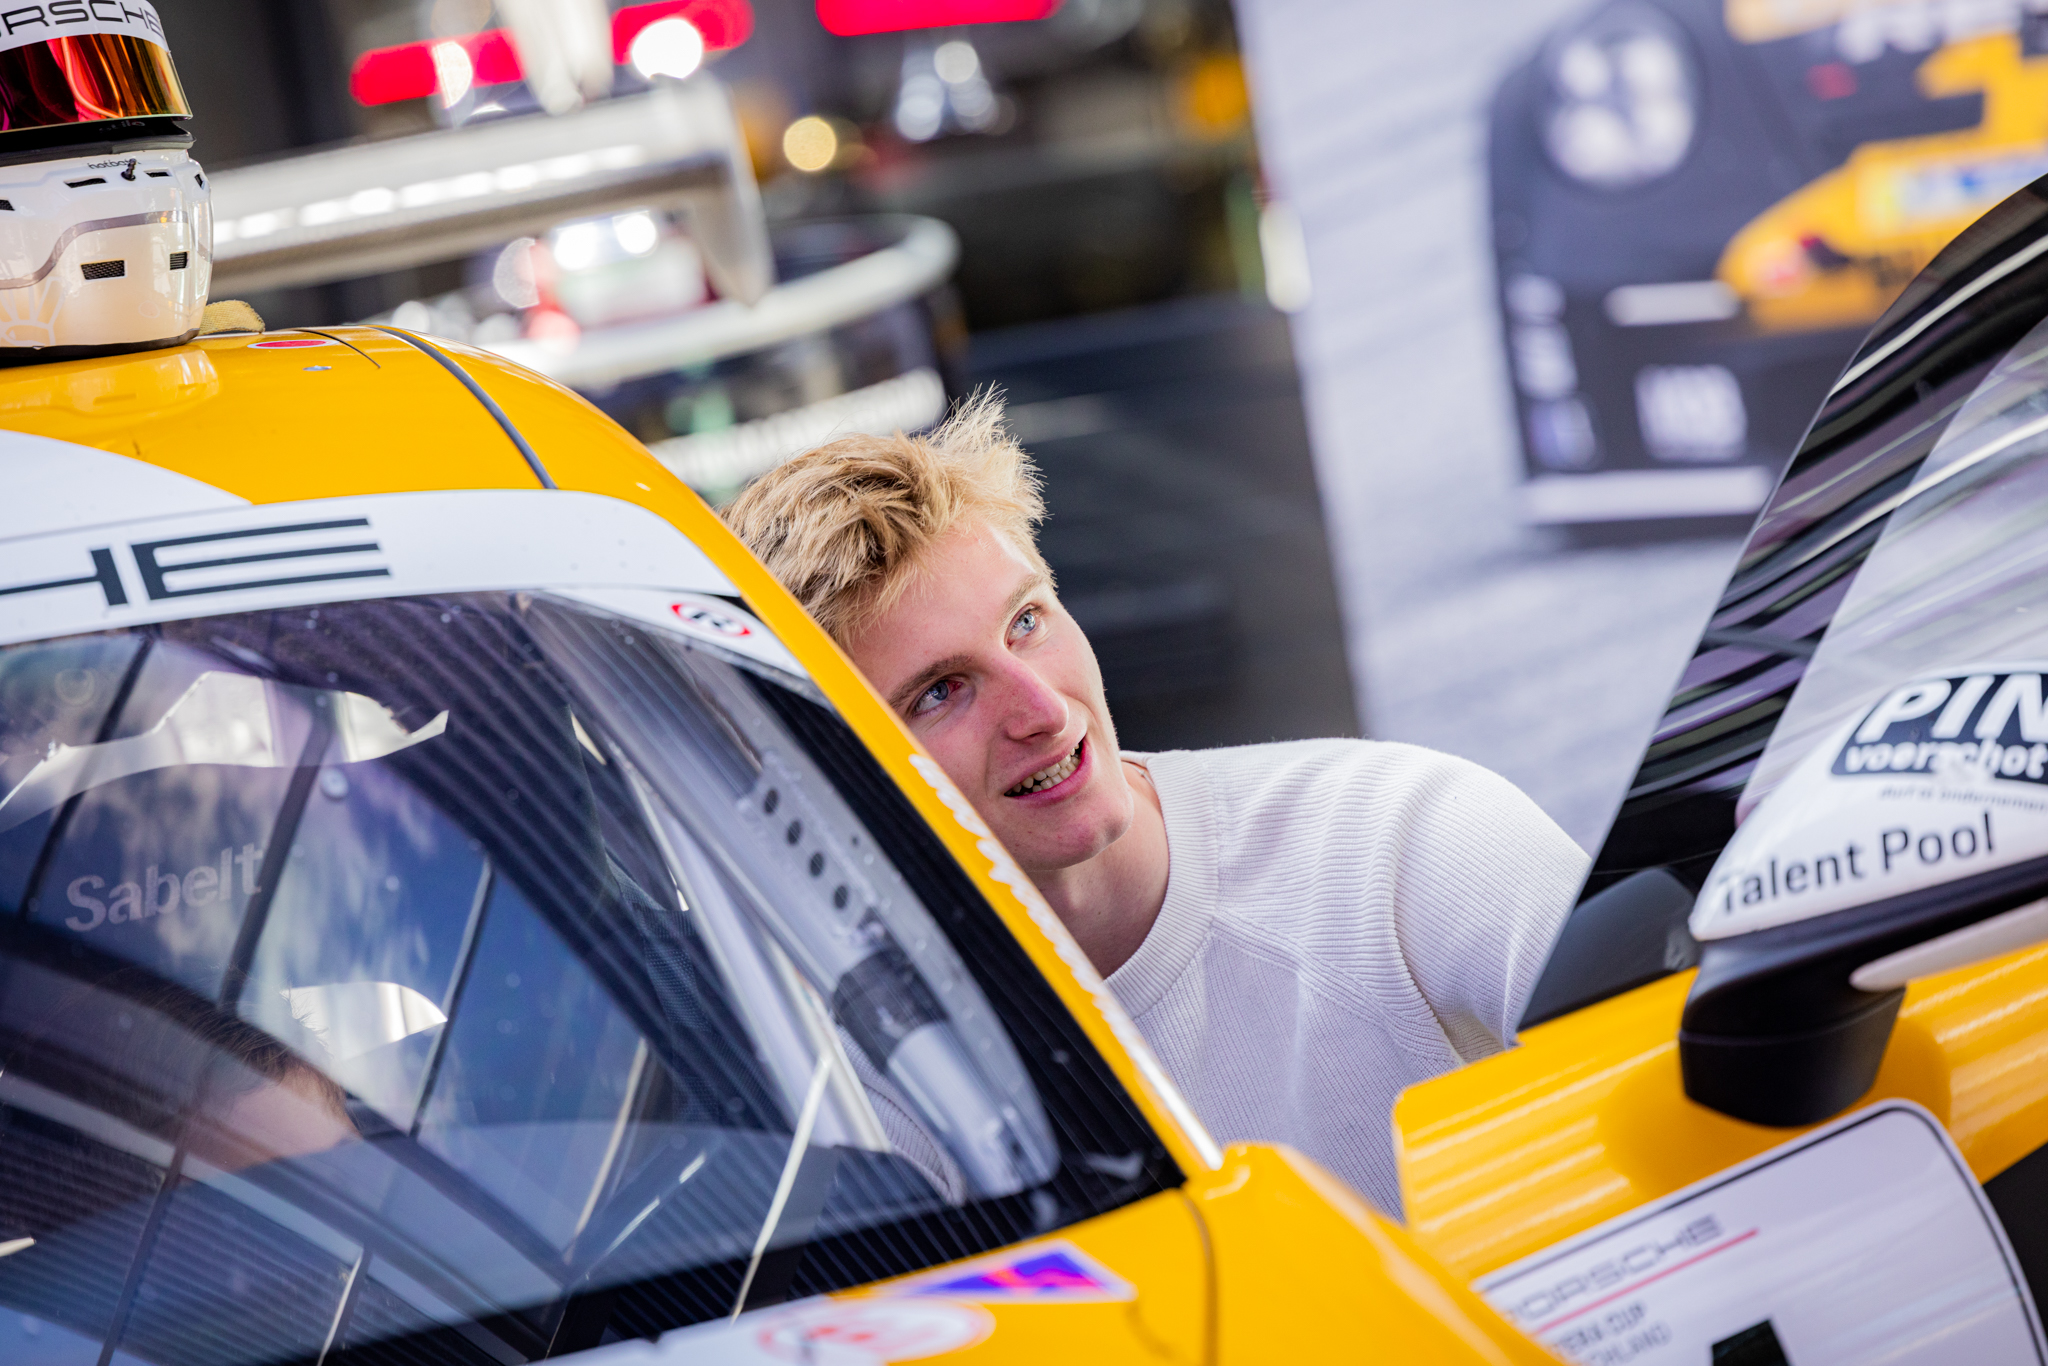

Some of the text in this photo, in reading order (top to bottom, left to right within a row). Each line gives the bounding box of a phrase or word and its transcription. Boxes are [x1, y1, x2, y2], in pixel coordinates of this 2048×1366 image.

[0, 0, 164, 39] RSCHE
[65, 843, 263, 932] Sabelt
[1718, 811, 1993, 914] Talent Pool
